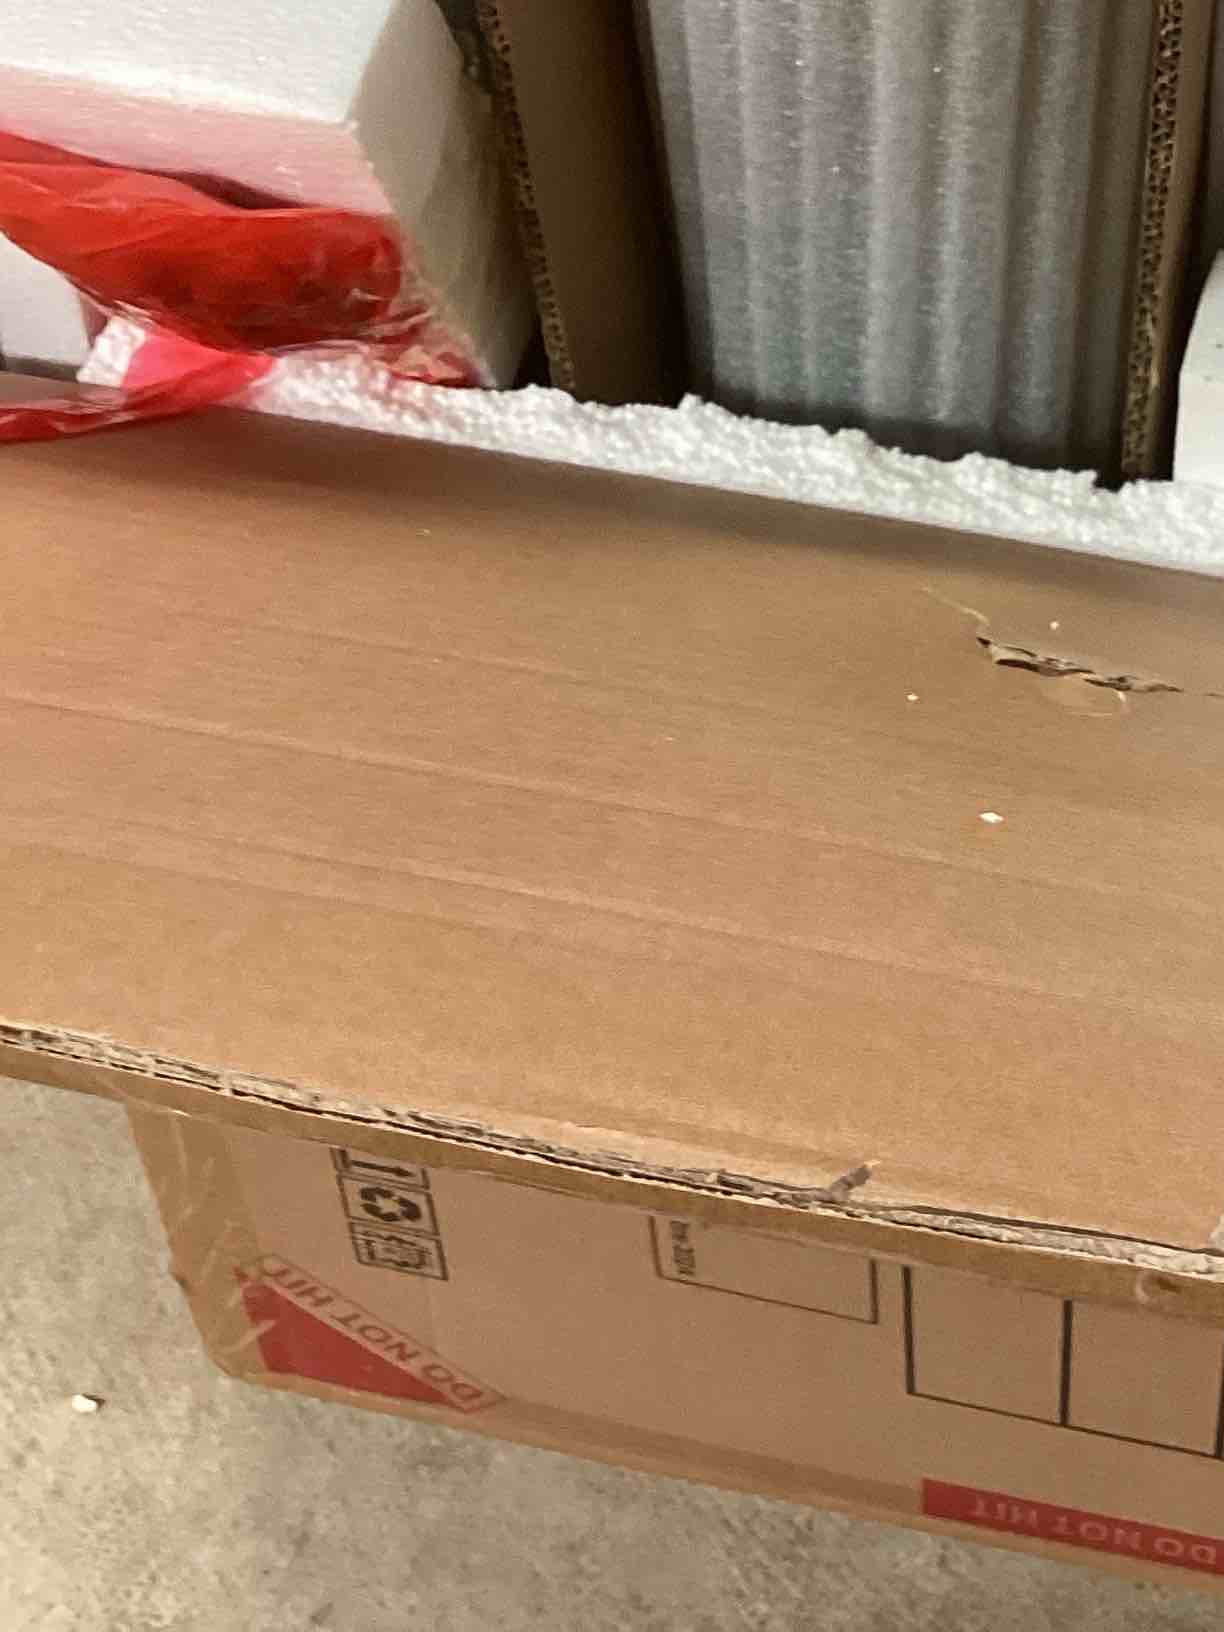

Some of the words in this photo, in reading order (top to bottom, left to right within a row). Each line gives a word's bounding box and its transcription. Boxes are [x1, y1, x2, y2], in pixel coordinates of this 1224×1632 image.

[328, 1311, 420, 1362] NOT
[421, 1362, 484, 1403] DO
[972, 1498, 1040, 1530] HIT
[1053, 1516, 1143, 1550] NOT
[1153, 1537, 1219, 1566] DO
